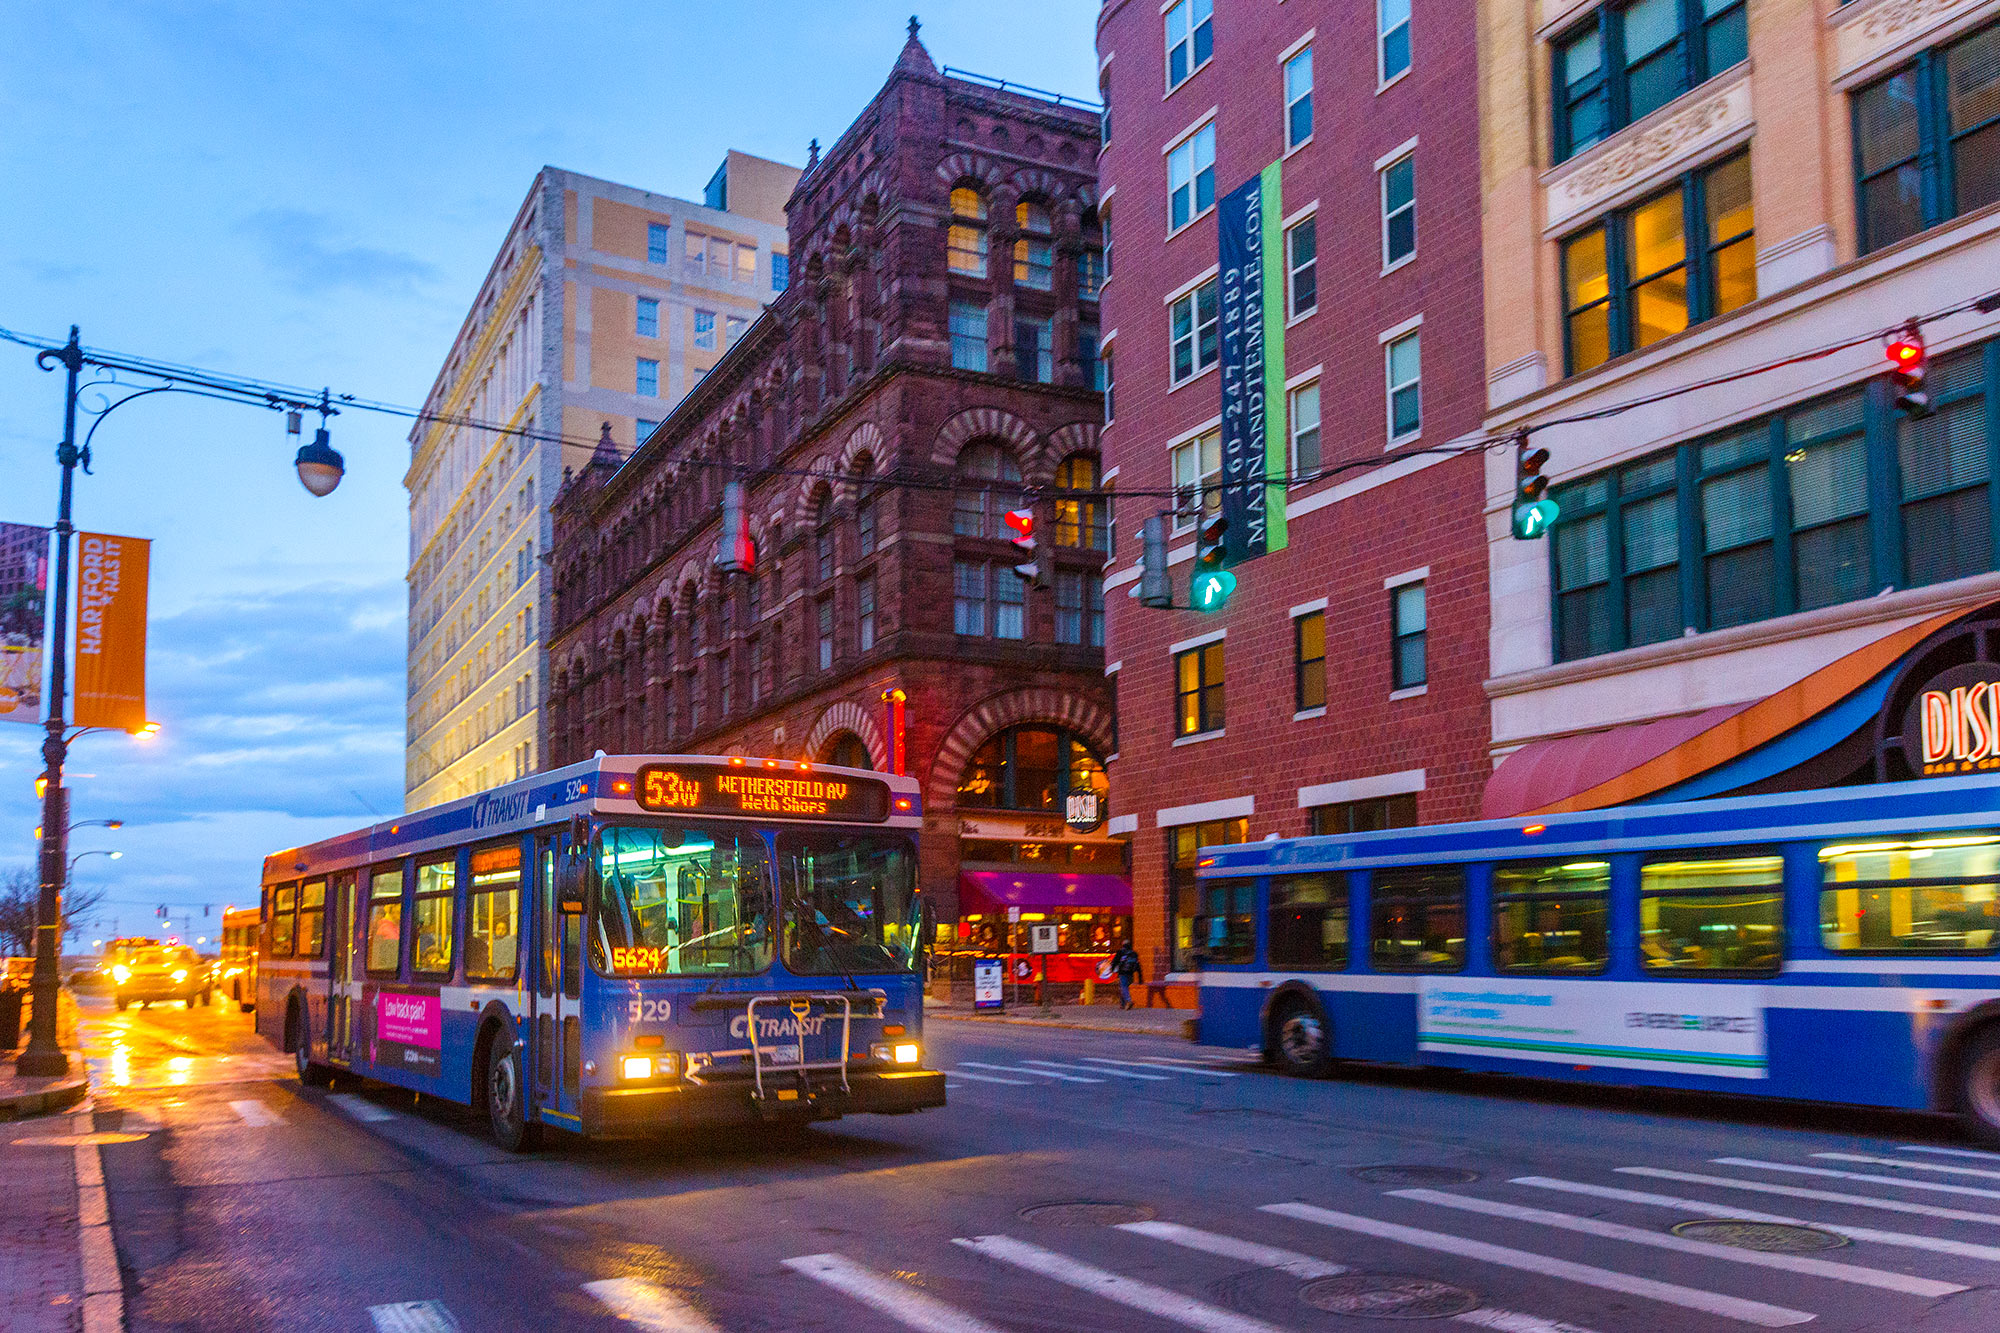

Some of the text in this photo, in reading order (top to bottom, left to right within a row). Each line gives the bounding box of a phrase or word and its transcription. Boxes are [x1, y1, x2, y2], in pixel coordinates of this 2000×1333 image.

[1244, 186, 1265, 548] MAINANDTEMPLE.COM
[103, 540, 122, 593] HAS IT
[79, 538, 104, 655] HARTFORD
[565, 779, 582, 802] 529
[718, 775, 824, 798] WETHERSFIELD
[826, 782, 848, 800] AV
[486, 790, 529, 826] TRANSIT
[782, 796, 827, 814] Shops
[1066, 794, 1098, 819] DISH
[613, 946, 660, 969] 5624
[628, 999, 671, 1022] 529
[759, 1017, 826, 1038] TRANSIT
